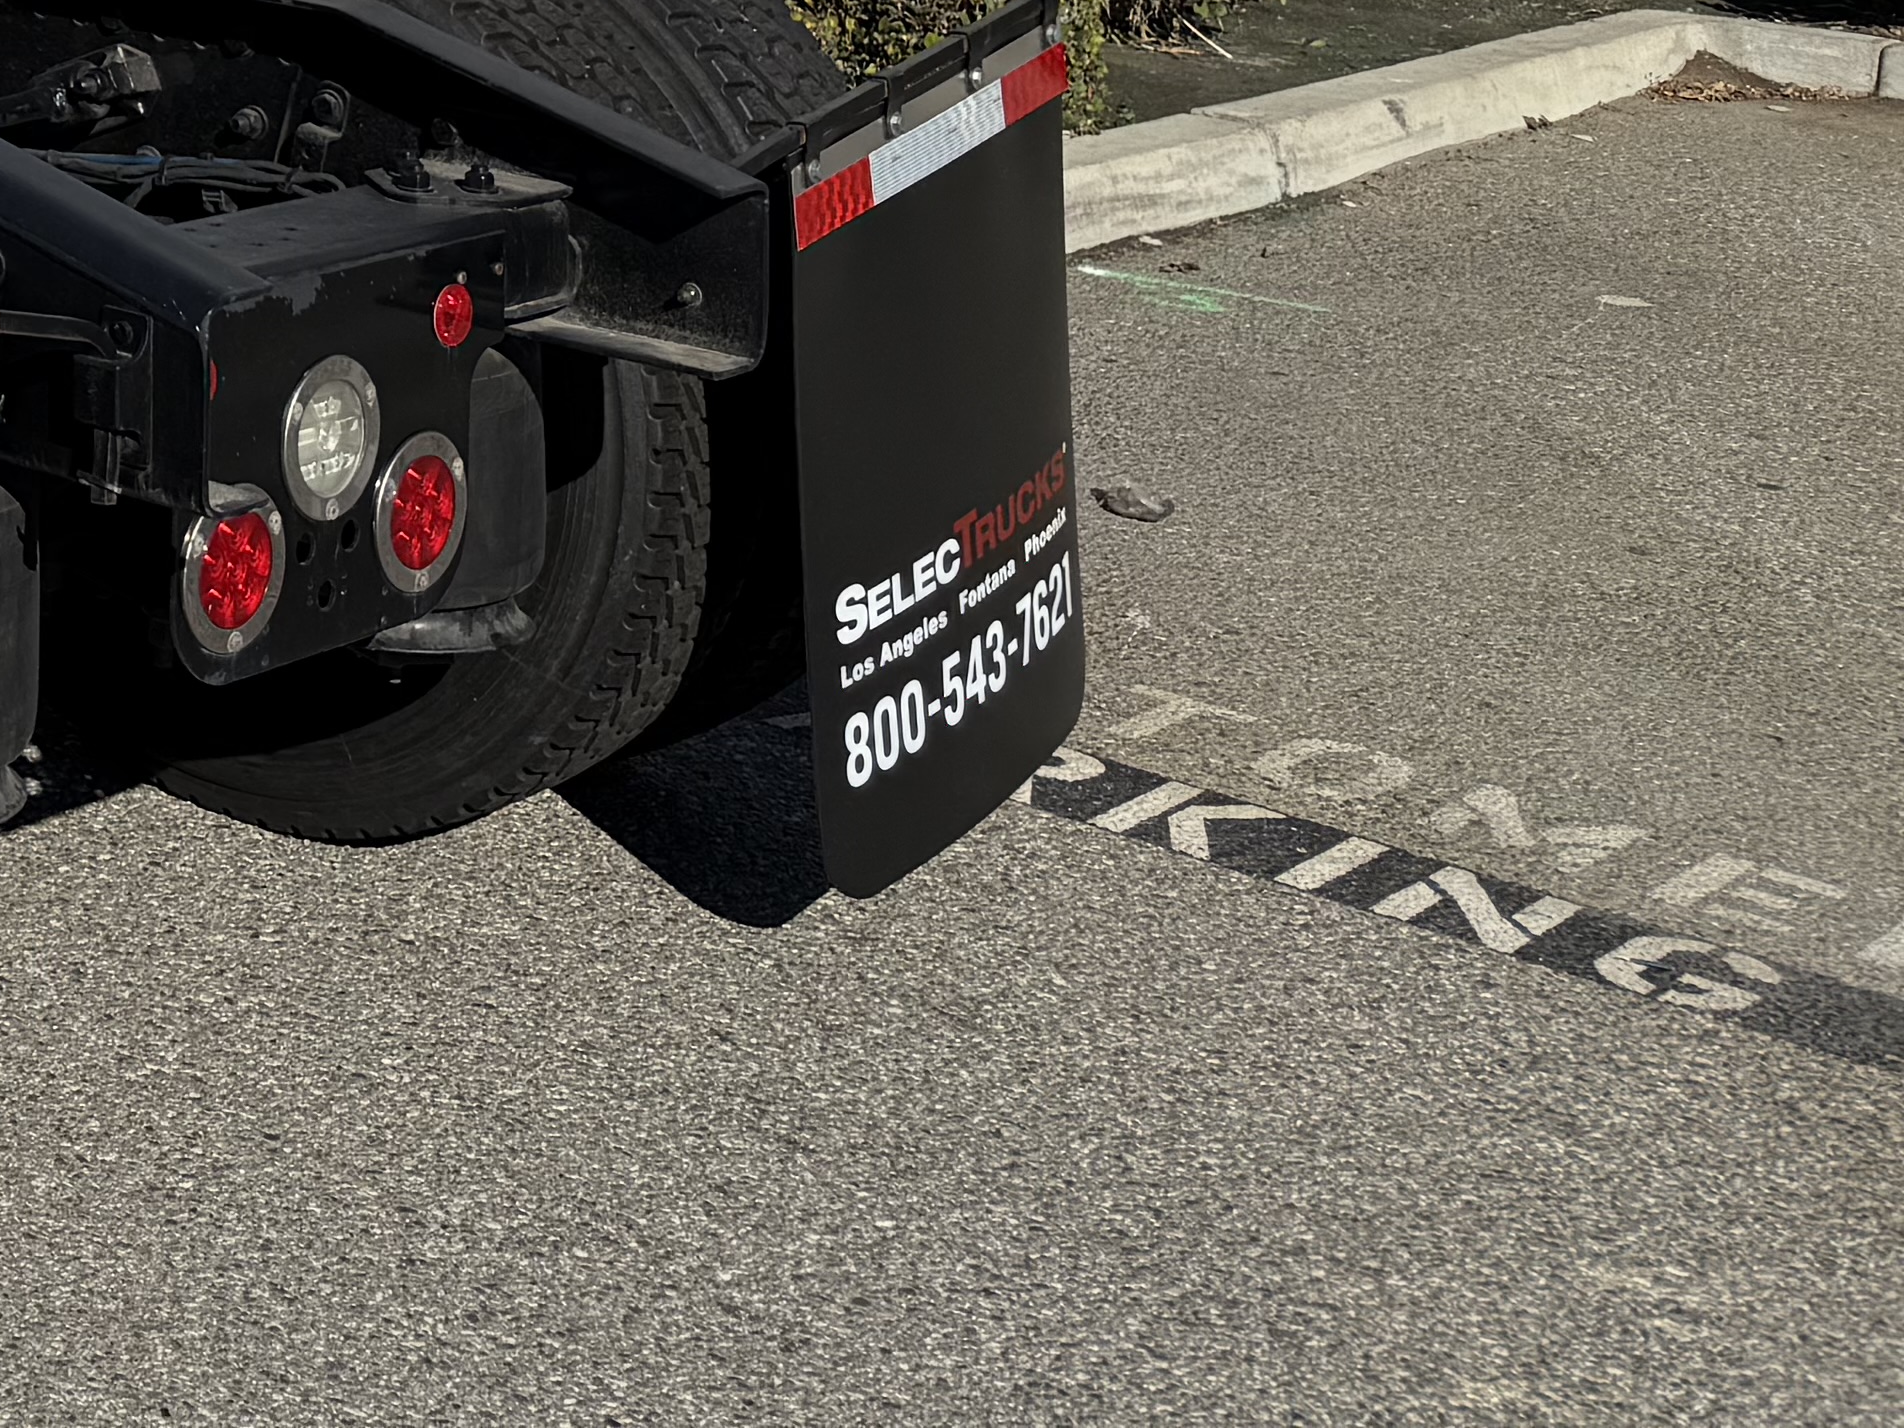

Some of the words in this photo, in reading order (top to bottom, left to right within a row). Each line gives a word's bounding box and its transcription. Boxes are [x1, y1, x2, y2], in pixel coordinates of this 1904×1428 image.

[835, 448, 1068, 645] SELECTRUCKS
[840, 656, 875, 690] Los
[879, 610, 949, 668] Angeles
[959, 558, 1017, 615] Fontana
[1024, 506, 1067, 562] Phoenix
[843, 549, 1074, 789] 800-543-7621
[1107, 684, 1904, 966] TOME
